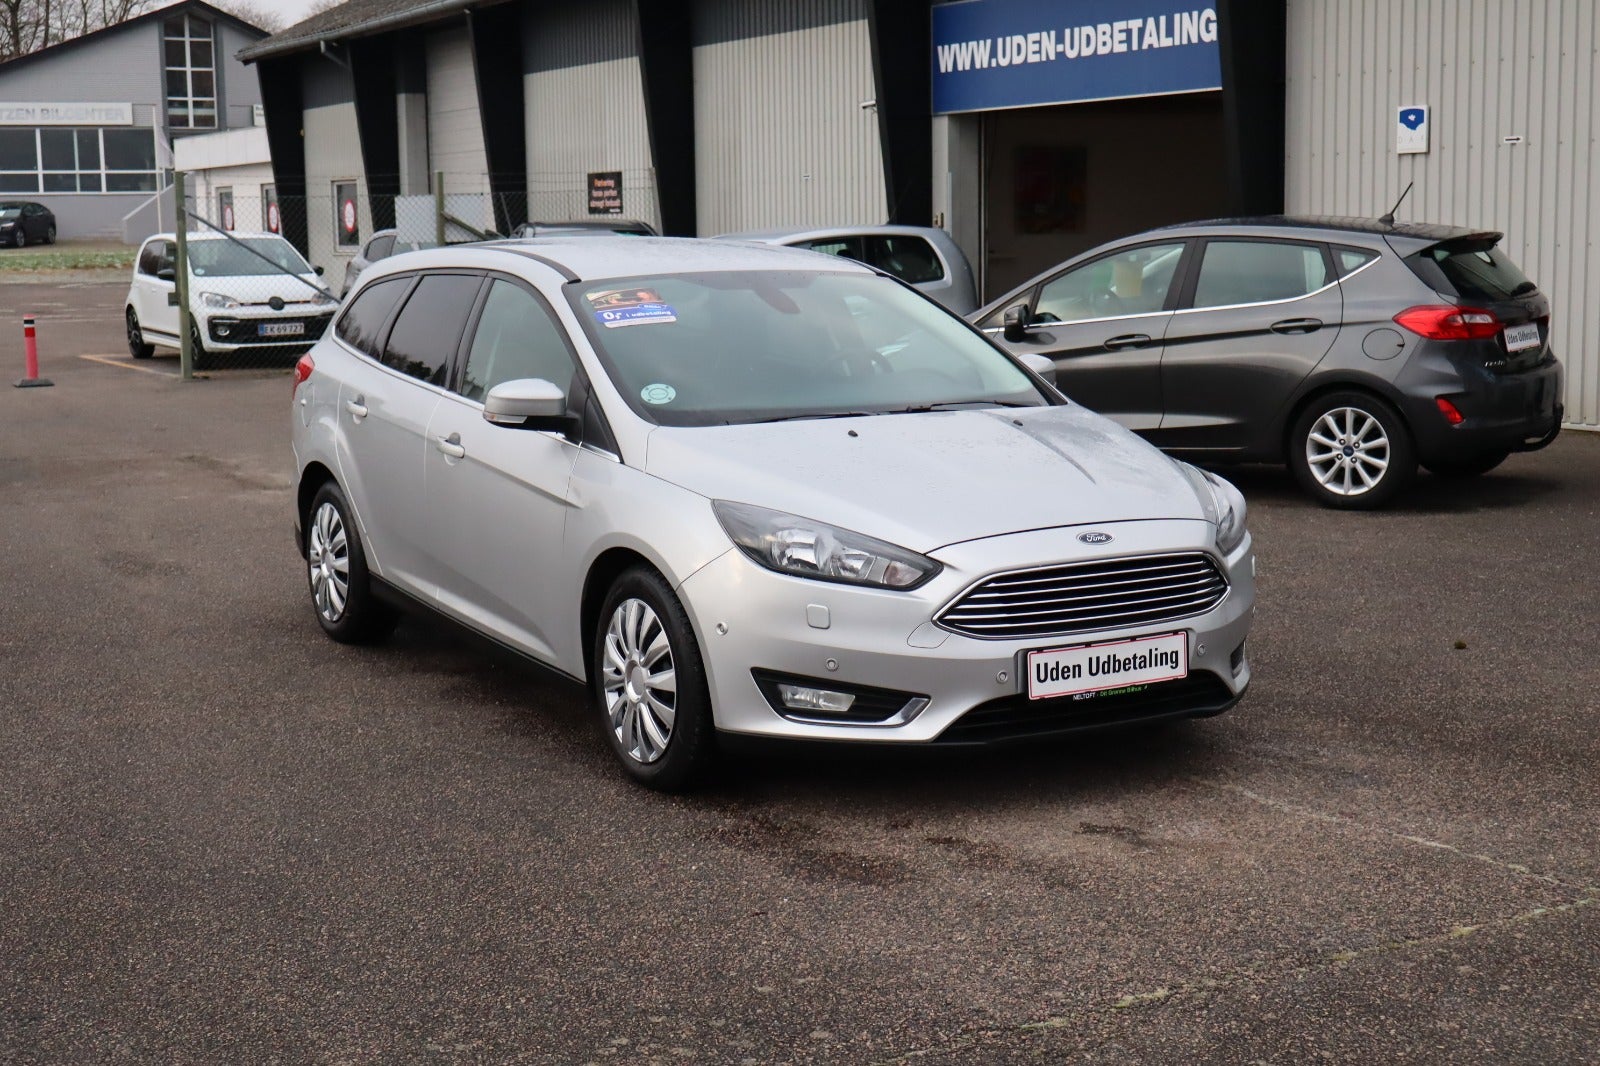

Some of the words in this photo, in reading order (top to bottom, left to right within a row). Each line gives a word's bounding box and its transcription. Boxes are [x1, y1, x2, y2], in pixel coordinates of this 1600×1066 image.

[937, 8, 1218, 73] WWW.UDEN-UDBETALING
[1086, 533, 1107, 542] Ford
[1036, 661, 1082, 683] Uden
[1088, 648, 1179, 677] Udbetaling
[1073, 692, 1096, 701] NELTOFT
